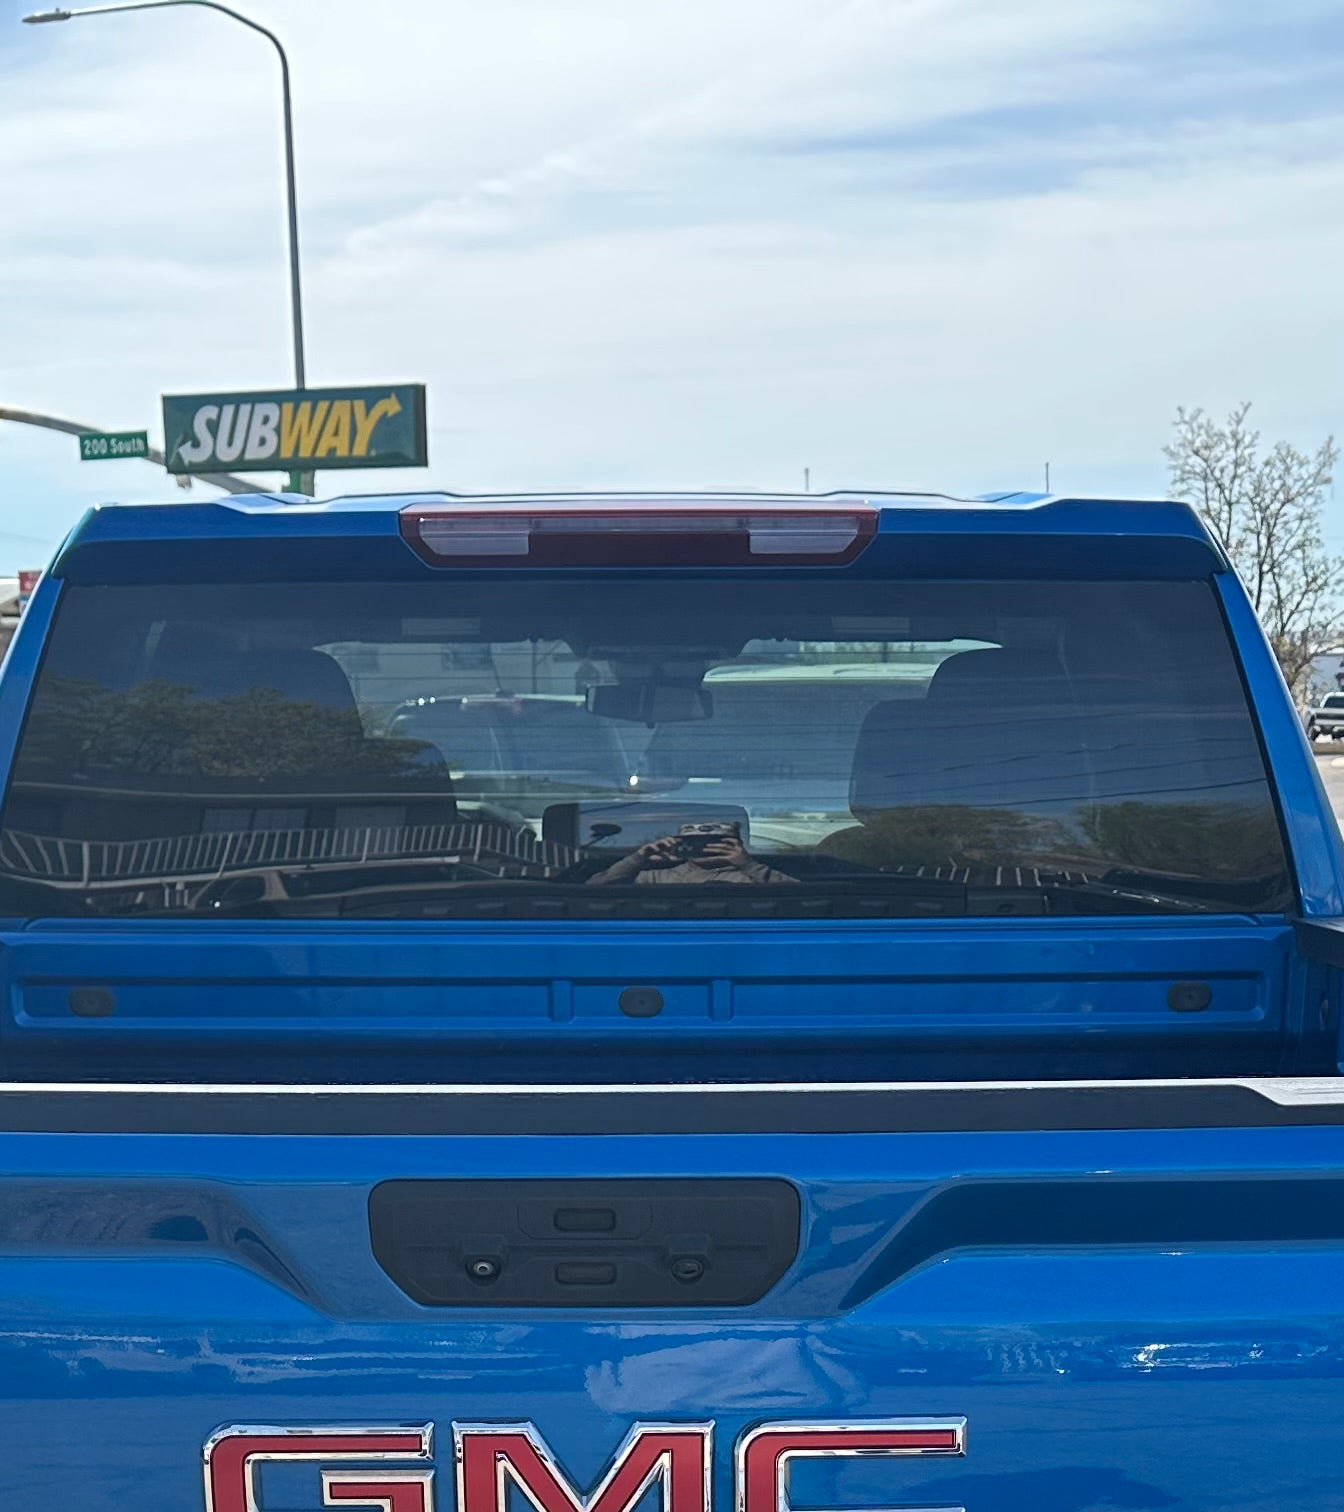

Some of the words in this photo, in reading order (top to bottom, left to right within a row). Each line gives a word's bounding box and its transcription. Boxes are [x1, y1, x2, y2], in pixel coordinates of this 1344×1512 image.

[83, 438, 108, 456] 200
[110, 437, 145, 454] South
[178, 394, 402, 466] SUBWAY
